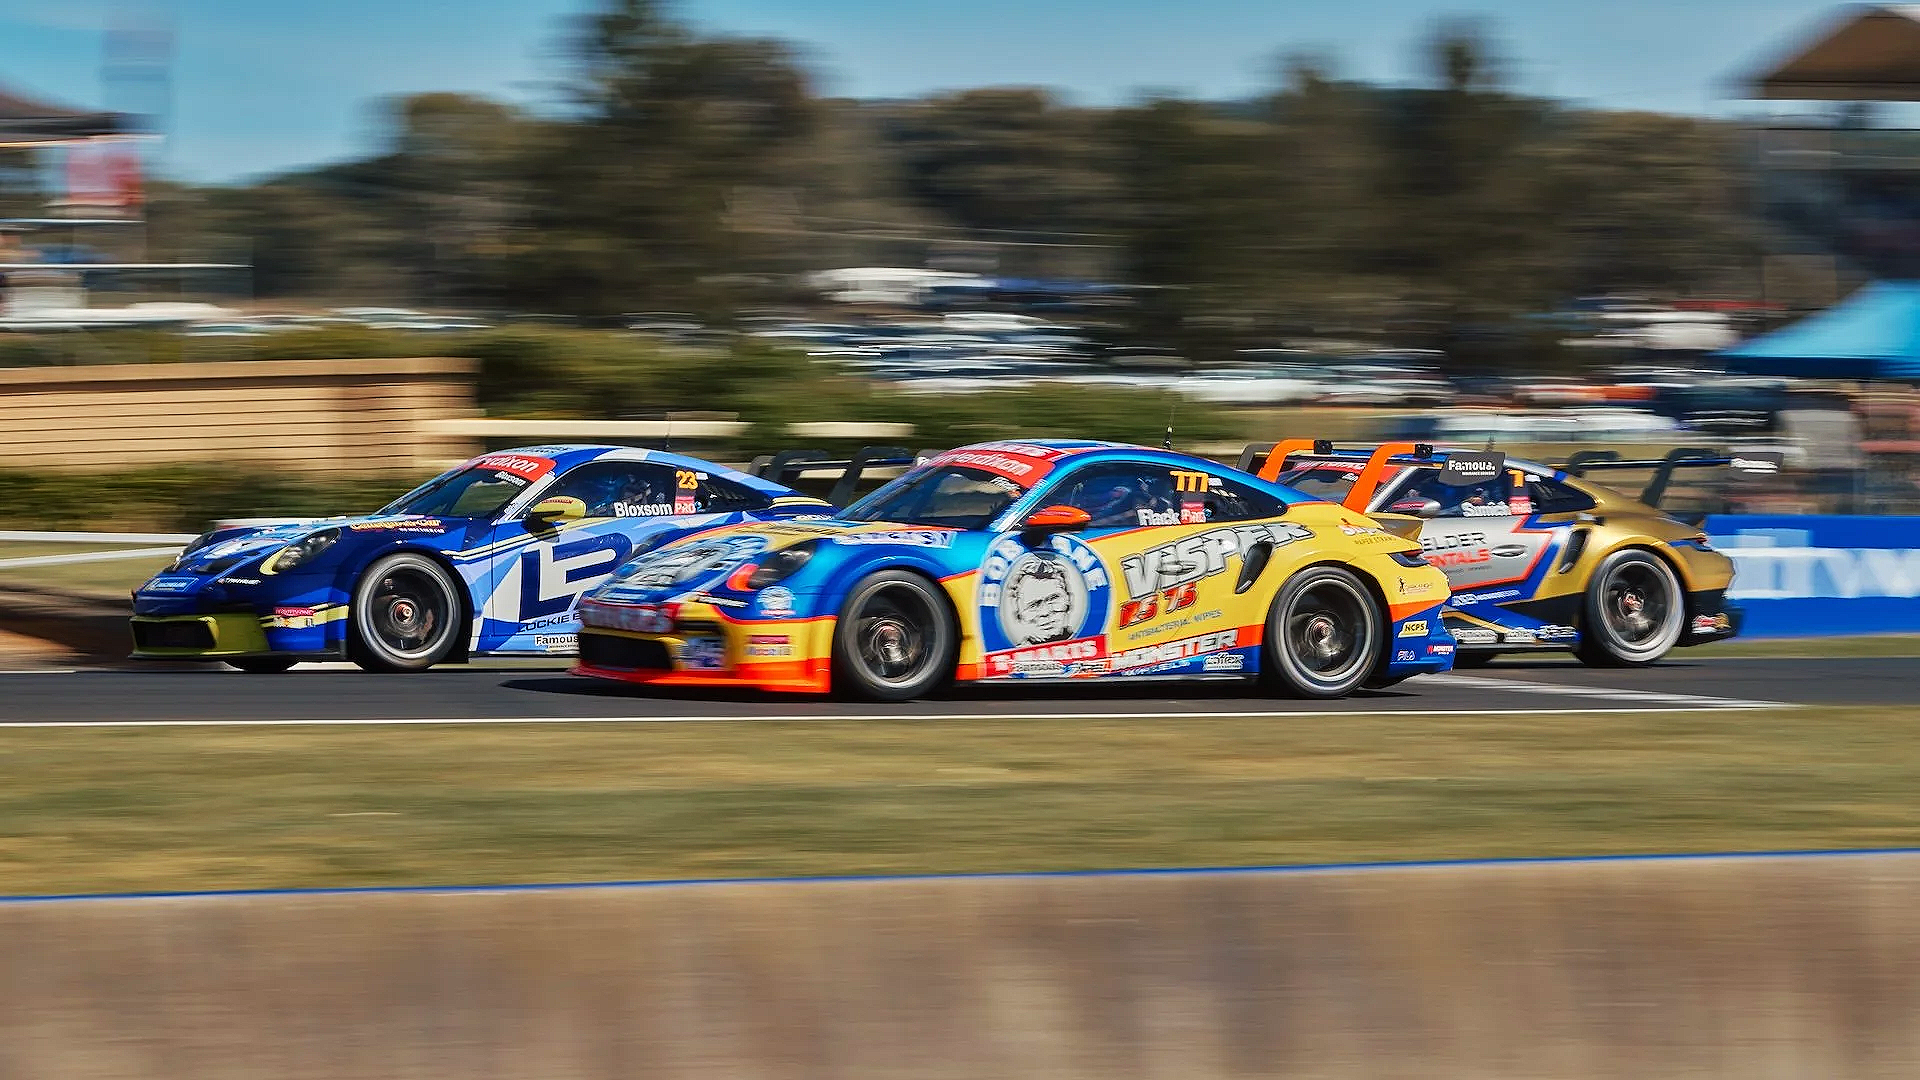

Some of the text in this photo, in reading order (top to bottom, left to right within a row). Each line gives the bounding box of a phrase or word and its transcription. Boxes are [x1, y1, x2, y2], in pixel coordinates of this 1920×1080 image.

[675, 470, 699, 490] 23
[1169, 470, 1209, 493] 777
[613, 502, 673, 517] Bloxsom
[675, 503, 696, 515] PRO
[1138, 509, 1181, 526] Flack
[1422, 532, 1487, 552] ELDER
[1051, 535, 1109, 592] ANE
[520, 614, 570, 632] LOCKIE
[535, 634, 579, 645] Famous
[1111, 629, 1237, 671] MONSTER
